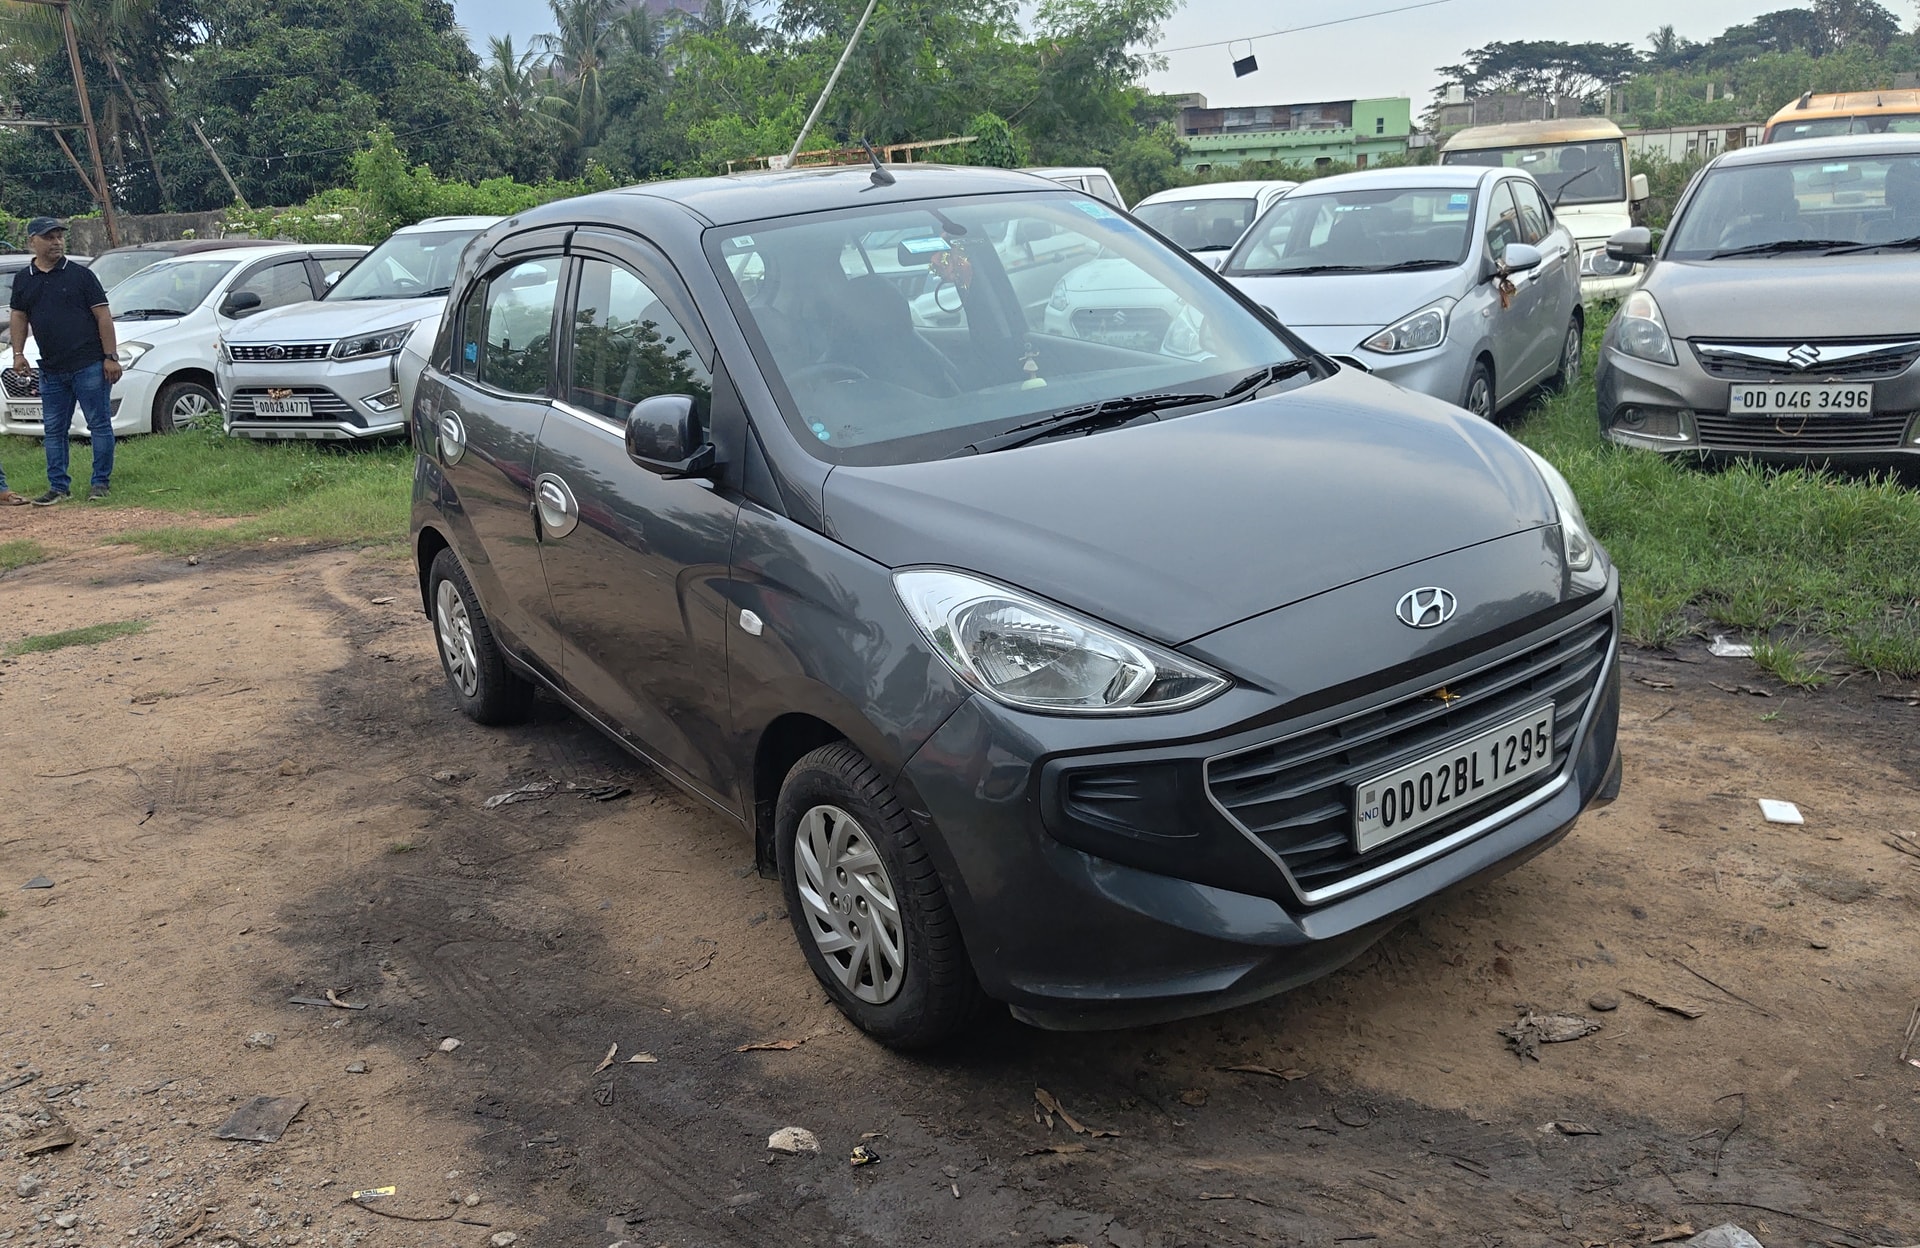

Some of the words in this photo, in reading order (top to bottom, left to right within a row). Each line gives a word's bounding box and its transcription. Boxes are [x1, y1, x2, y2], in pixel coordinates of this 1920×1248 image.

[1744, 391, 1767, 408] OD
[1775, 391, 1811, 408] 04G
[1818, 391, 1868, 408] 3496
